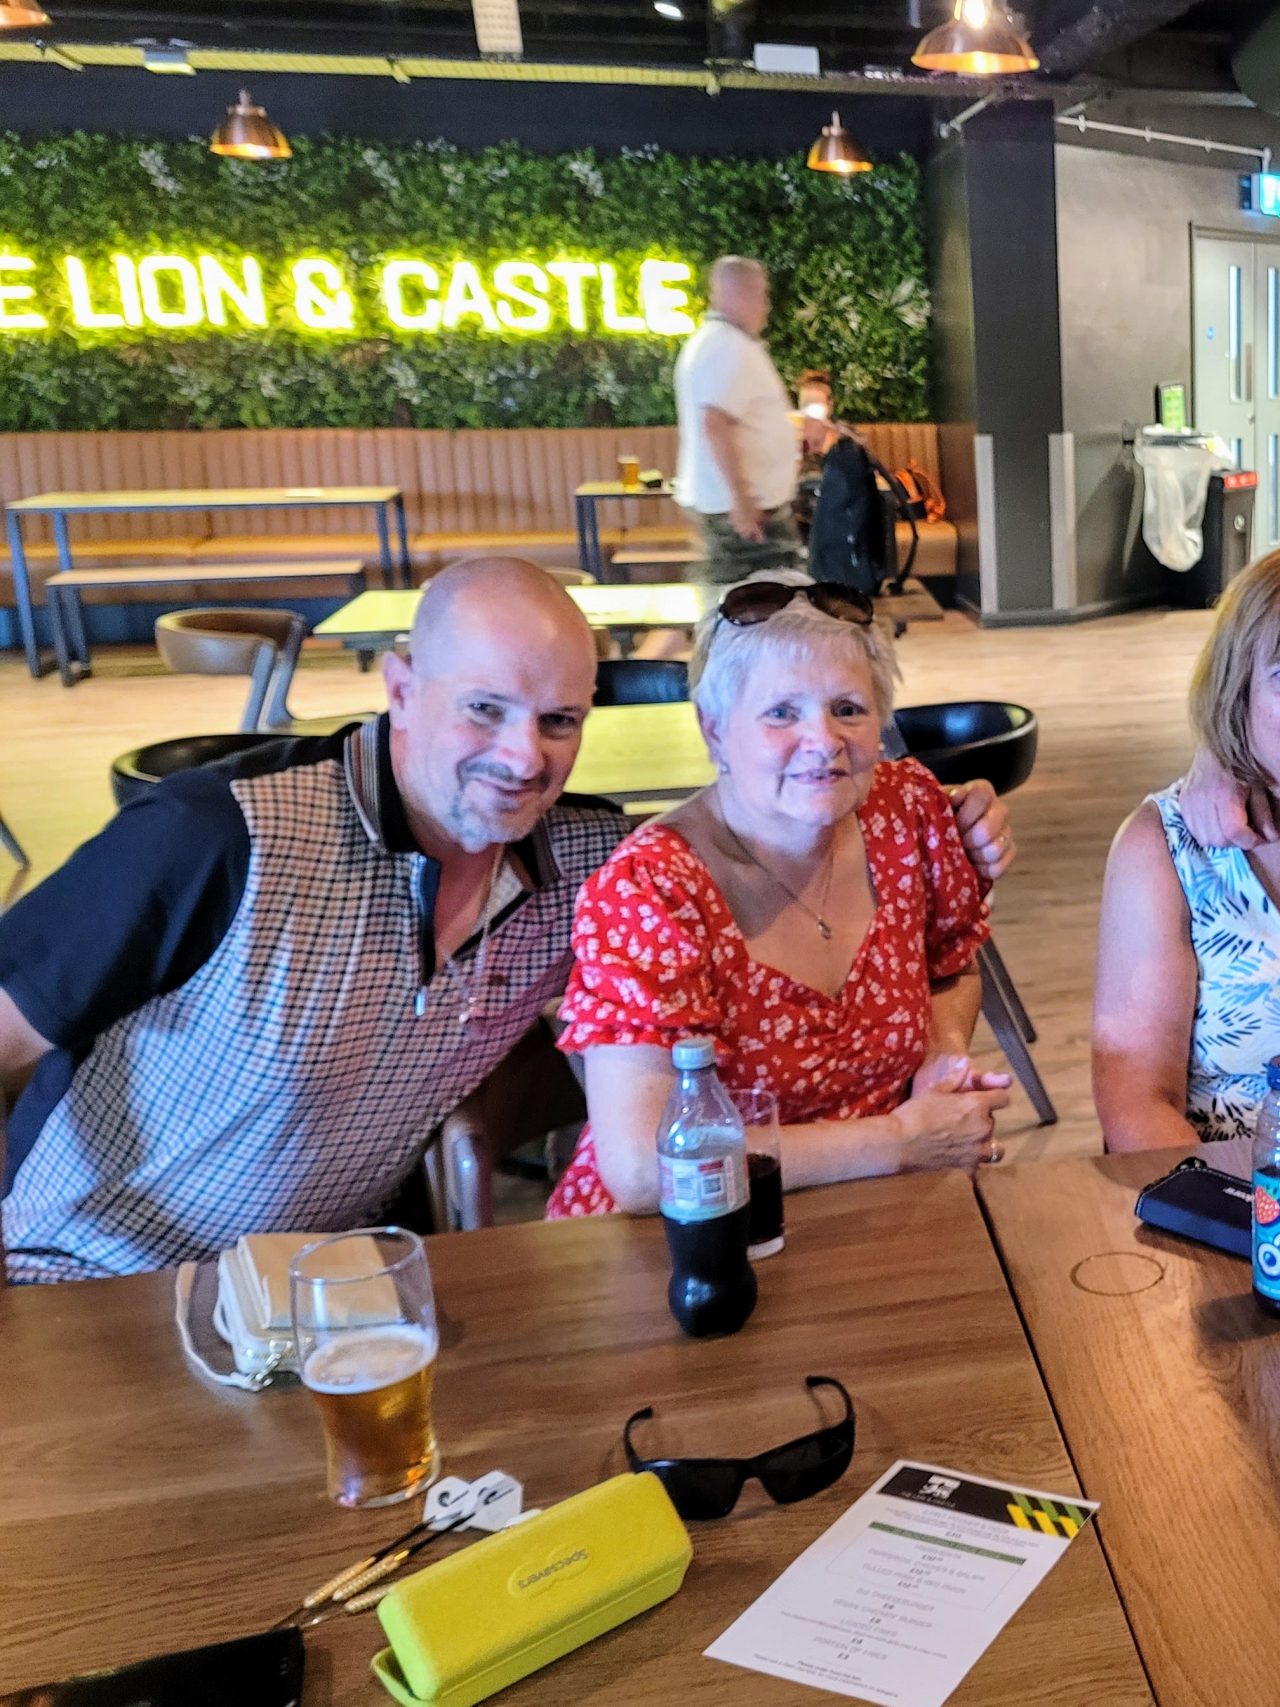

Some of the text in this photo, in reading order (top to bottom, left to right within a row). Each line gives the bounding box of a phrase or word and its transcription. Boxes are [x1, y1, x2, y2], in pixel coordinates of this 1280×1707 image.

[66, 256, 267, 329] LION
[295, 257, 352, 330] &
[382, 259, 694, 335] CASTLE
